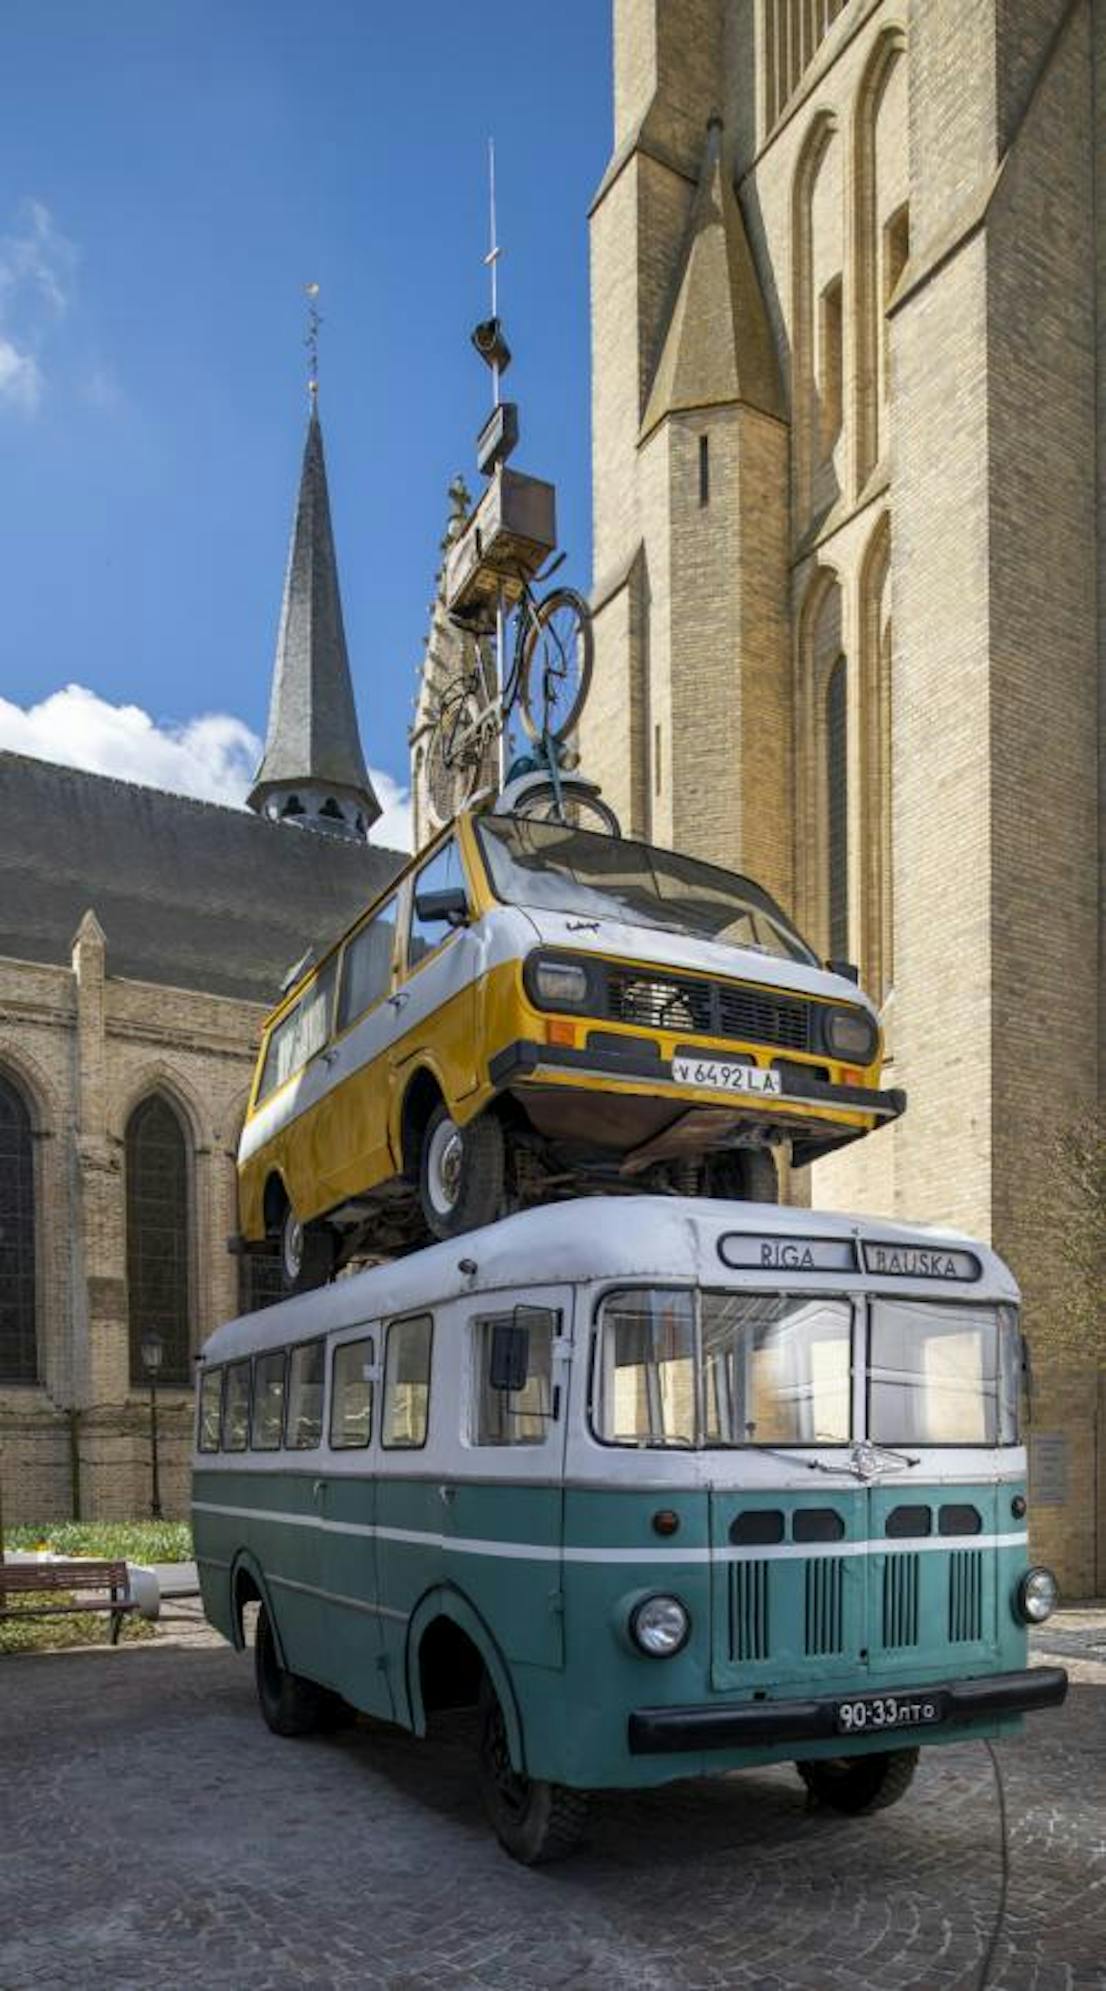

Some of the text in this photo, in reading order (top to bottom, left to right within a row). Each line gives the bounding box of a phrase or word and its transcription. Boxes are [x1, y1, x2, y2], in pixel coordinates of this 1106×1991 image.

[694, 1064, 742, 1087] 6492
[747, 1069, 776, 1091] LA
[876, 1249, 956, 1276] BAUSKA
